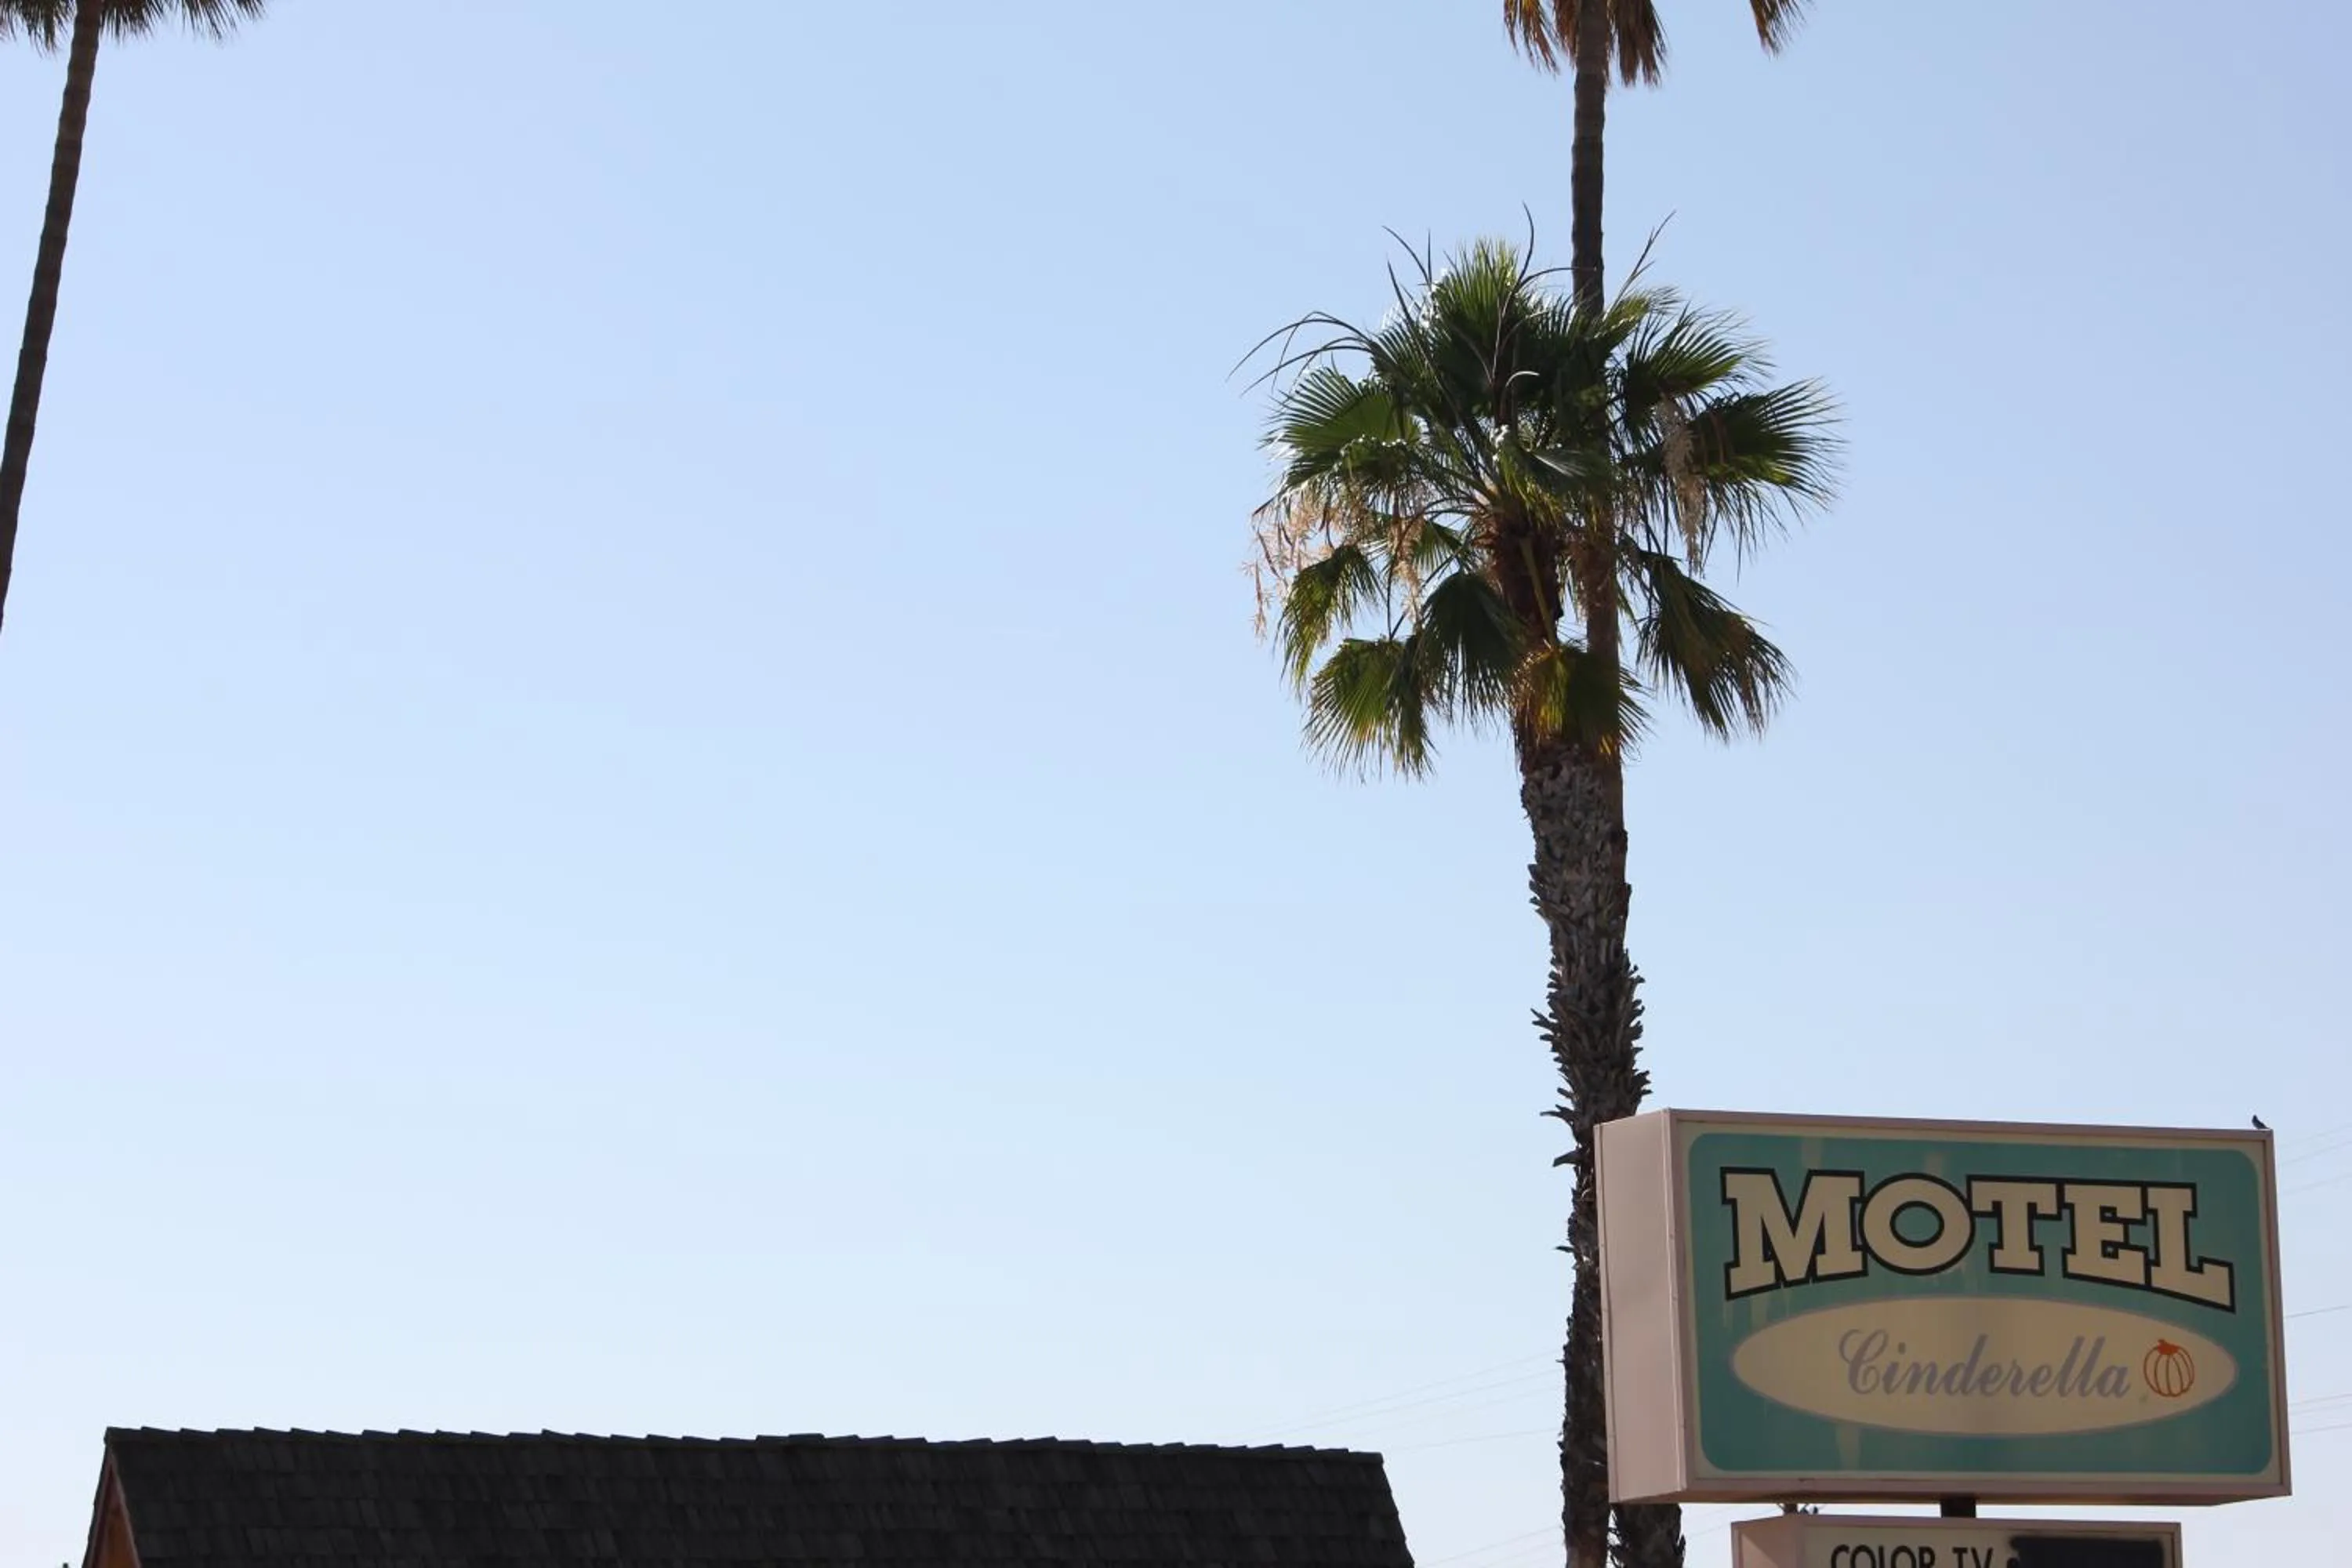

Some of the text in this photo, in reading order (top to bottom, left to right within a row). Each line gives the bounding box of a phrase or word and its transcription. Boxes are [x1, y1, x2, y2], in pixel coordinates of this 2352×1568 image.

[1720, 1167, 2236, 1312] MOTEL
[1838, 1329, 2130, 1398] Cinderella
[1952, 1547, 1993, 1568] TV
